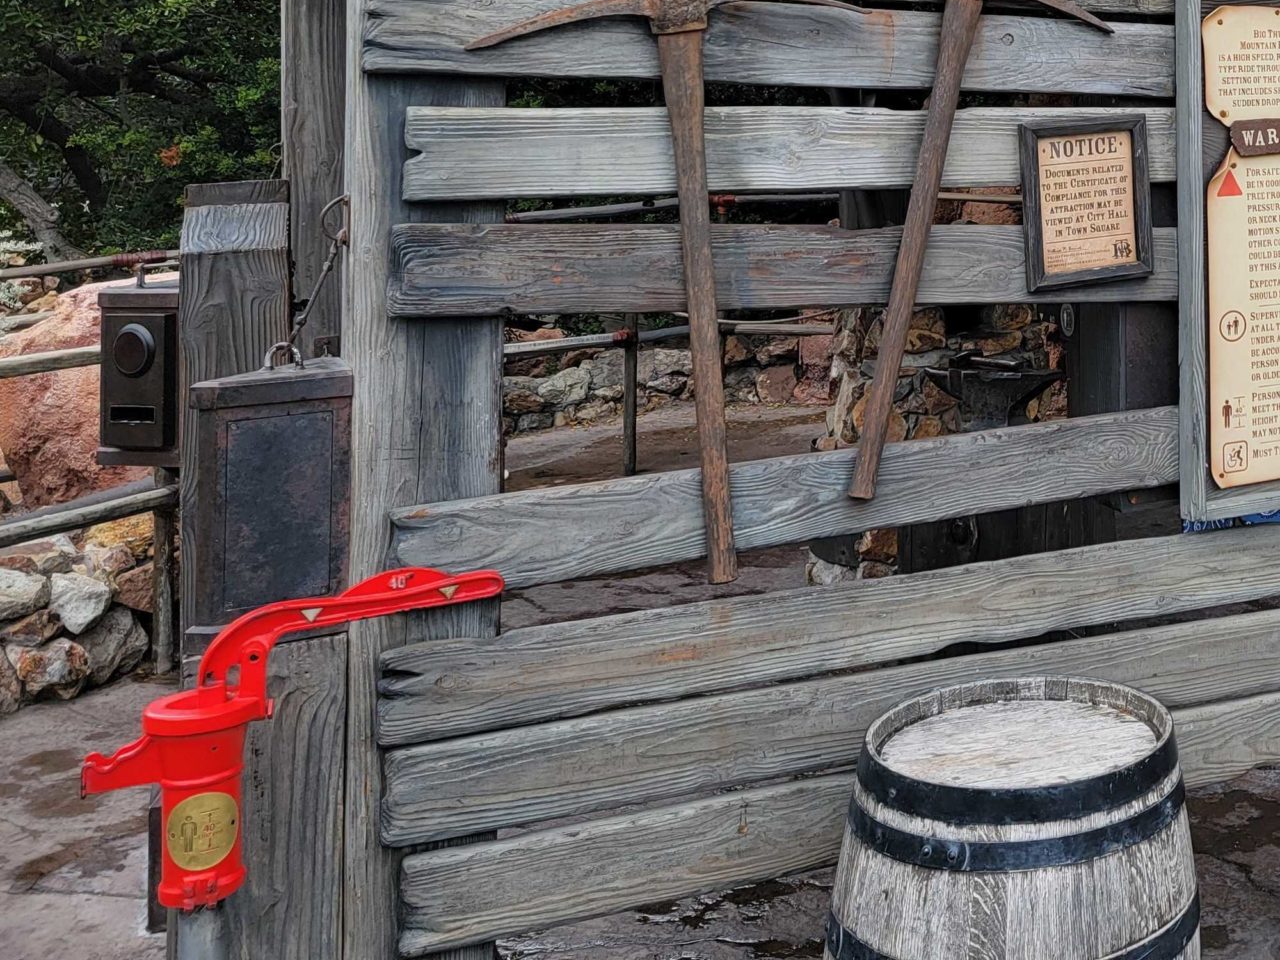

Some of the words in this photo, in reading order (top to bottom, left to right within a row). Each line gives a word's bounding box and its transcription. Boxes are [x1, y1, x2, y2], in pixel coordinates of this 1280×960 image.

[1254, 30, 1267, 38] BIG
[1240, 41, 1276, 49] MOUNTAIN
[1219, 65, 1236, 73] TYPE
[1222, 77, 1251, 85] SETTING
[1232, 99, 1260, 107] SUDDEN
[1050, 136, 1117, 159] NOTICE
[1045, 167, 1089, 179] DOCUMENTS
[1092, 165, 1123, 174] RELATED
[1247, 168, 1261, 176] FOR
[1054, 182, 1067, 190] THE
[1071, 177, 1117, 188] CERTIFICATE
[1044, 192, 1091, 202] COMPLIANCE
[1050, 203, 1094, 214] ATTRACTION
[1097, 201, 1112, 209] MAY
[1045, 217, 1072, 226] VIEWED
[1087, 213, 1104, 222] CITY
[1108, 210, 1128, 218] HALL
[1259, 216, 1277, 224] NECK
[1066, 226, 1087, 236] TOWN
[1090, 223, 1120, 233] SQUARE
[1248, 227, 1274, 236] MOTION
[1249, 240, 1272, 248] OTHER
[1249, 251, 1272, 260] COULD
[1260, 263, 1277, 271] THIS
[1250, 292, 1277, 300] SHOULD
[1251, 325, 1260, 333] AT
[1261, 324, 1274, 332] ALL
[1251, 360, 1279, 369] PERSON
[1251, 373, 1261, 381] OR
[1252, 404, 1270, 414] MEET
[1252, 416, 1278, 426] HEIGHT
[1252, 429, 1267, 438] MAY
[1253, 448, 1272, 458] MUST
